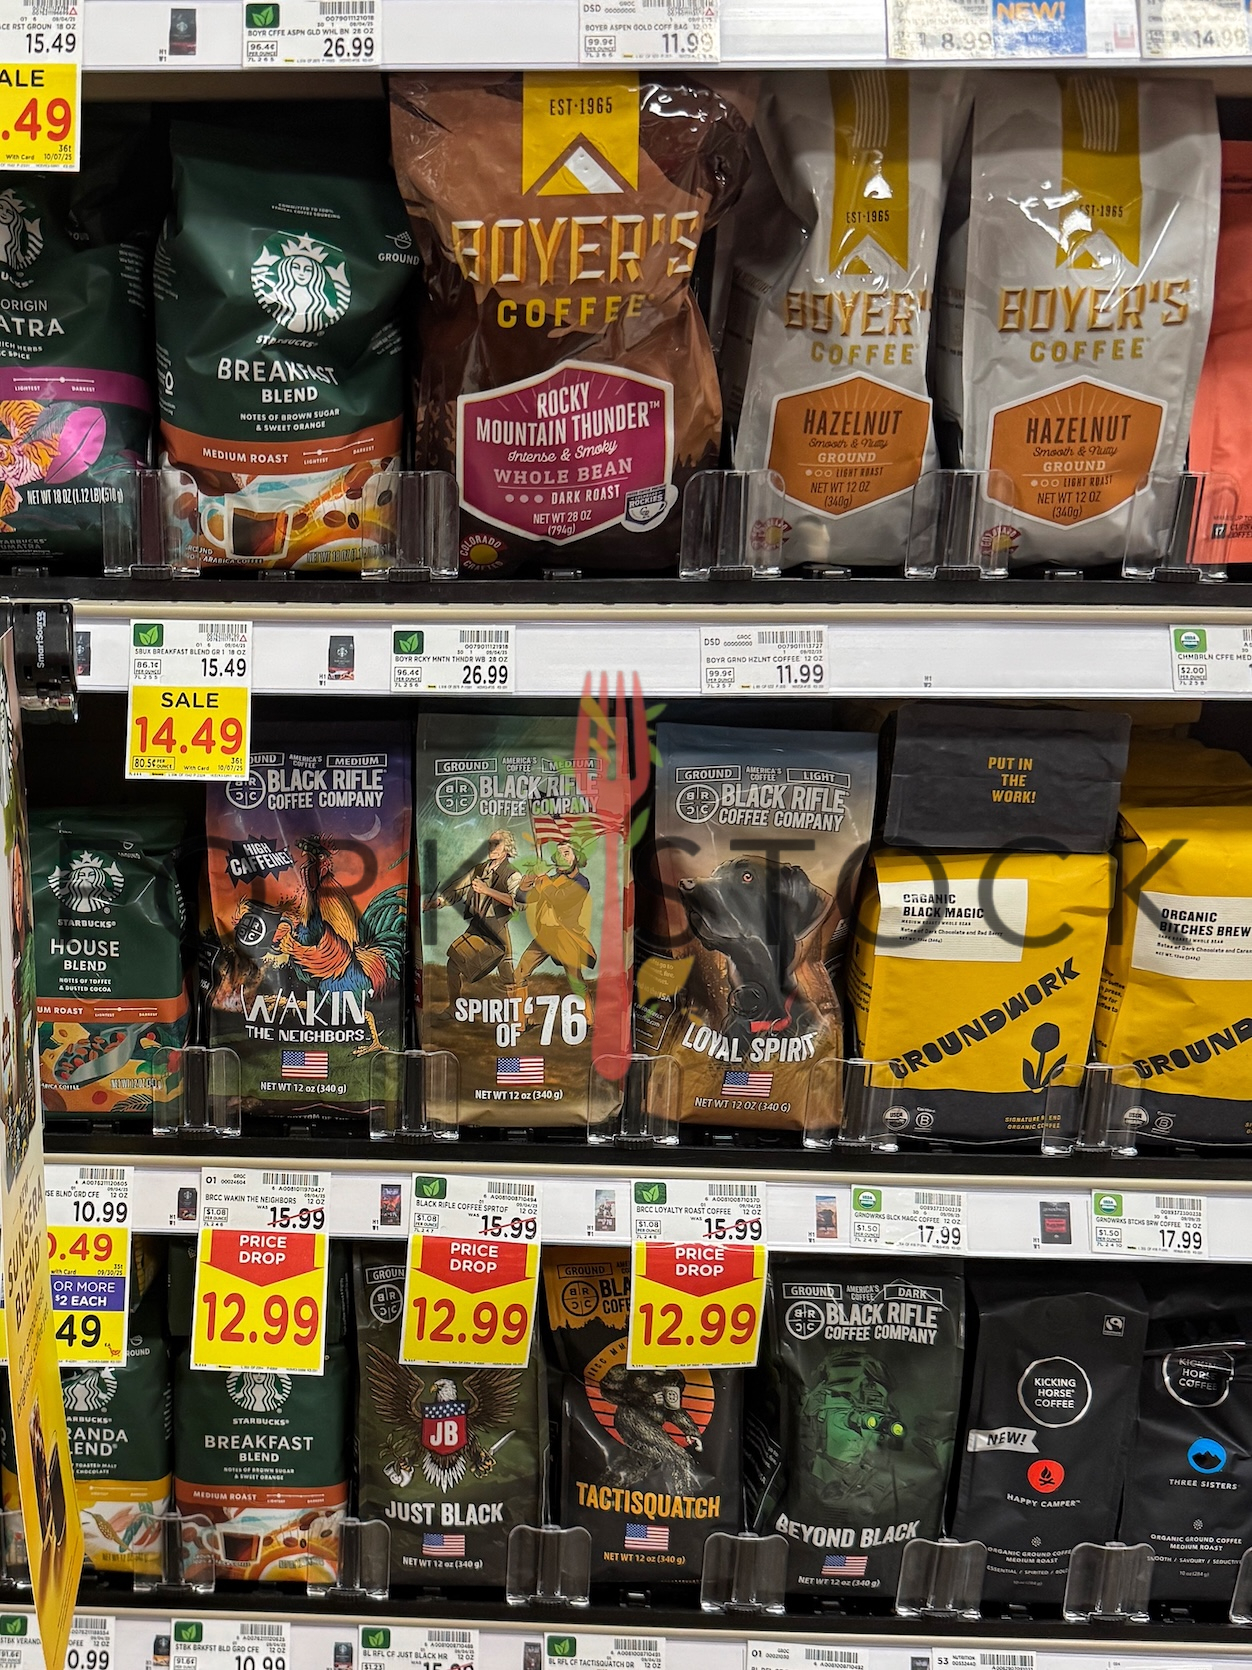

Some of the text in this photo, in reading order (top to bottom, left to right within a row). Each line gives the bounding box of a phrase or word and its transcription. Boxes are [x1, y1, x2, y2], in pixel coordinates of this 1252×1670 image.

[26, 33, 76, 53] 15.49
[323, 37, 374, 57] 26.99
[998, 278, 1191, 334] BOYER'S
[8, 351, 30, 360] SPICE
[261, 386, 319, 404] BLEND
[537, 381, 590, 419] ROCKY
[240, 408, 340, 421] NOTES OF BROWN SUGAR
[803, 408, 903, 436] HAZELNUT
[256, 421, 326, 432] & SWEET ORANGE
[1026, 414, 1131, 445] HAZELNUT
[817, 452, 876, 464] GROUND
[493, 458, 633, 484] WHOLE BEAN
[1043, 460, 1106, 472] GROUND
[551, 484, 620, 505] DARK ROAST
[810, 481, 870, 493] NET WT 12 OZ
[704, 638, 720, 646] DSD
[201, 658, 246, 677] 15.49
[462, 665, 508, 684] 26.99
[776, 664, 824, 684] 11.99
[161, 692, 219, 709] SALE
[135, 716, 243, 755] 14.49
[335, 757, 379, 766] MEDIUM
[502, 757, 538, 765] AMERICA'S
[506, 764, 531, 772] COFFEE
[987, 756, 1033, 771] PUT IN
[267, 769, 384, 792] BLACK RIFLE
[803, 771, 836, 783] LIGHT
[1001, 774, 1026, 787] THE
[991, 790, 1037, 804] WORK!
[243, 842, 271, 856] HIGH
[903, 906, 985, 919] BLACK MAGIC
[1161, 908, 1218, 923] ORGANIC
[1159, 921, 1252, 937] BITCHES BREW
[50, 938, 120, 958] HOUSE
[63, 960, 107, 972] BLEND
[53, 1007, 84, 1015] ROAST
[888, 956, 1080, 1080] GROUNDWORK
[496, 1023, 521, 1048] OF
[682, 1022, 818, 1063] LOYAL SPIRIT
[56, 1190, 72, 1198] BLND
[260, 1196, 296, 1204] NEIGHBORS
[73, 1201, 128, 1223] 10.99
[416, 1200, 437, 1208] BLACK
[438, 1201, 455, 1209] RIFLE
[457, 1202, 482, 1211] COFFEE
[654, 1206, 682, 1214] LOYALTY
[854, 1212, 885, 1220] GRNDWRKS
[239, 1234, 287, 1249] PRICE
[1159, 1229, 1202, 1249] 17.99
[239, 1251, 286, 1265] DROP
[675, 1247, 725, 1261] PRICE
[450, 1258, 498, 1273] DROP
[53, 1281, 115, 1293] OR MORE
[898, 1287, 927, 1299] DARK
[55, 1295, 107, 1307] $2 EACH
[202, 1291, 319, 1346] 12.99
[412, 1297, 528, 1346] 12.99
[639, 1302, 757, 1346] 12.99
[824, 1324, 937, 1346] COFFEE COMPANY
[1034, 1377, 1077, 1388] KICKING
[1034, 1399, 1075, 1409] COFFEE
[429, 1420, 459, 1446] JB
[986, 1431, 1027, 1447] NEW!
[204, 1435, 314, 1451] BREAKFAST
[193, 1491, 257, 1501] MEDIUM ROAST
[575, 1481, 721, 1521] TACTISQUATCH
[384, 1500, 504, 1526] JUST BLACK
[775, 1513, 921, 1549] BEYOND BLACK
[1150, 1533, 1242, 1545] ORGANIC GROUND COFFEE
[1200, 1543, 1223, 1551] ROAST
[604, 1552, 619, 1561] NET
[620, 1553, 634, 1562] WT
[635, 1554, 645, 1562] 12
[657, 1554, 675, 1564] (340
[677, 1555, 686, 1565] g)
[247, 1646, 259, 1654] CFE
